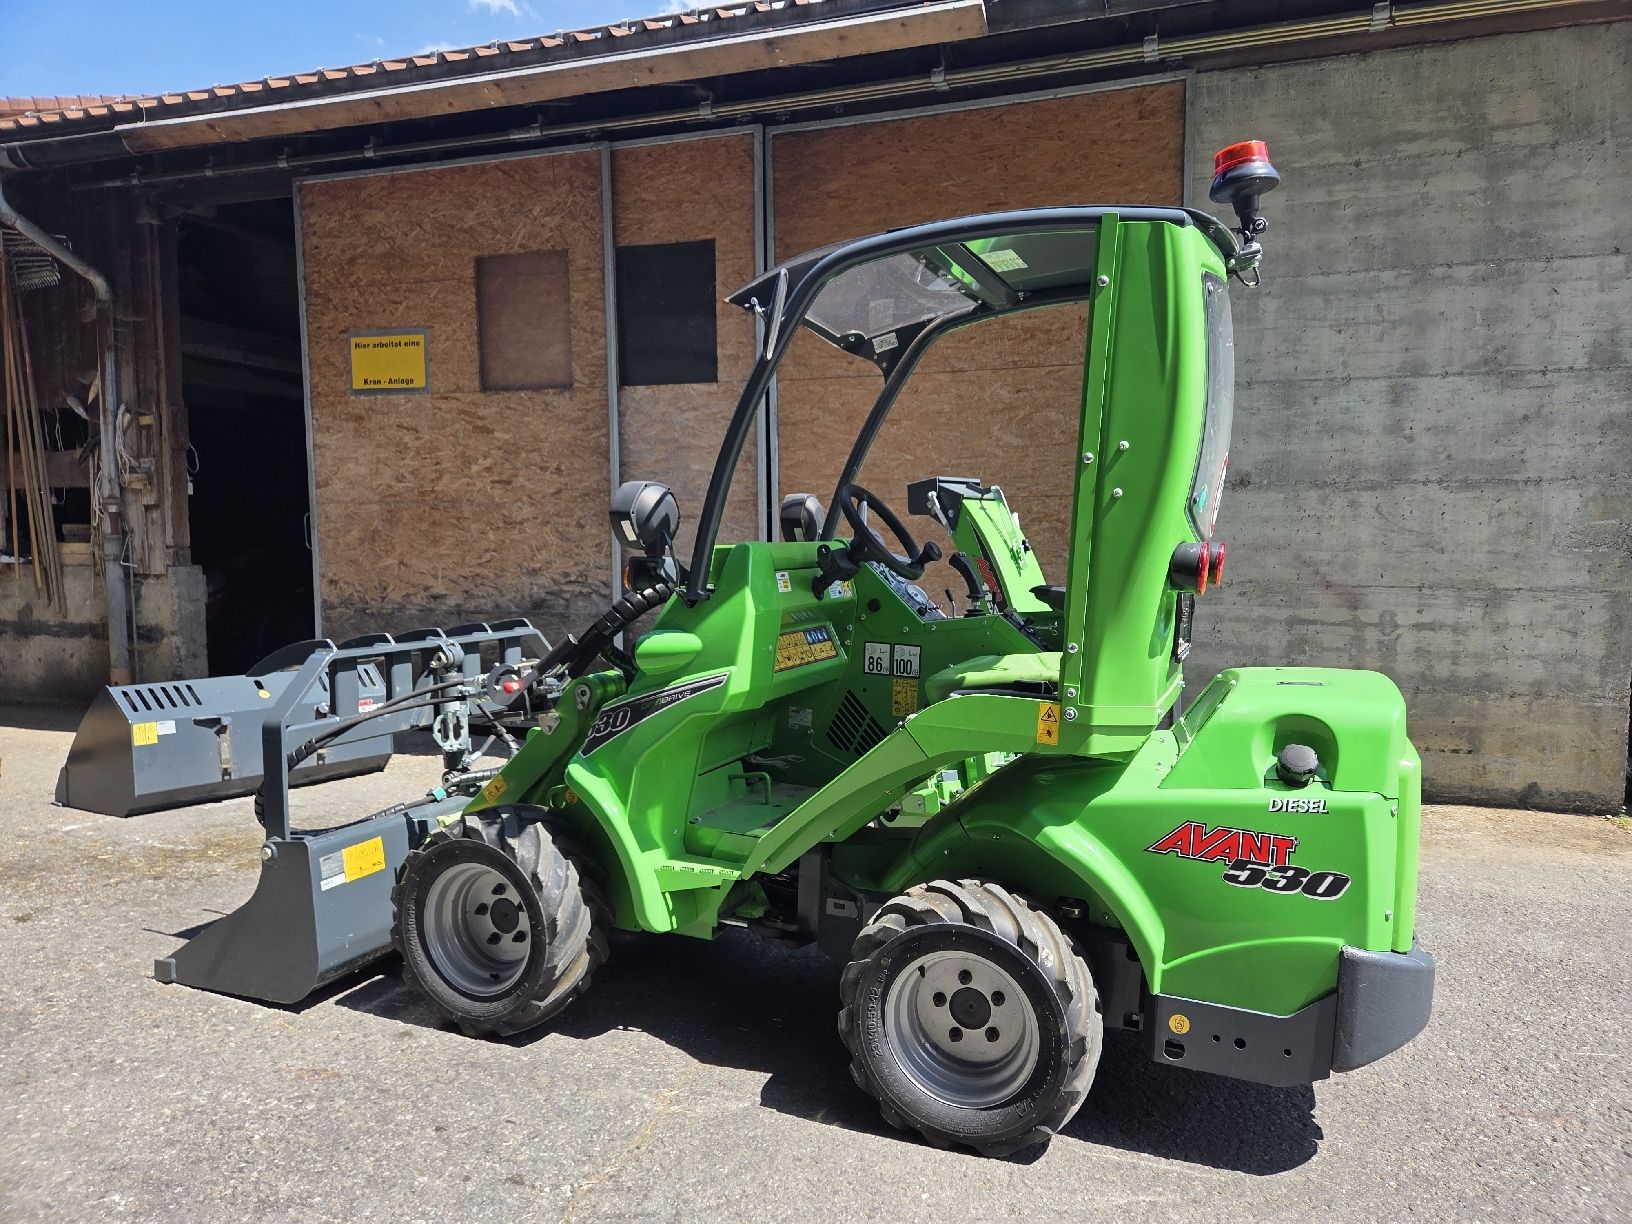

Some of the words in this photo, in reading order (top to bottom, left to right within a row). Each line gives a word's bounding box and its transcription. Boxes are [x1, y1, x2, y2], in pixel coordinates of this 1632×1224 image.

[372, 340, 402, 349] arbeitet
[363, 378, 381, 386] Kran
[387, 377, 414, 386] Anlage
[868, 656, 883, 673] 86
[895, 658, 912, 675] 100
[1268, 798, 1330, 815] DIESEL
[1144, 820, 1298, 867] AVANT
[1221, 857, 1352, 901] 530
